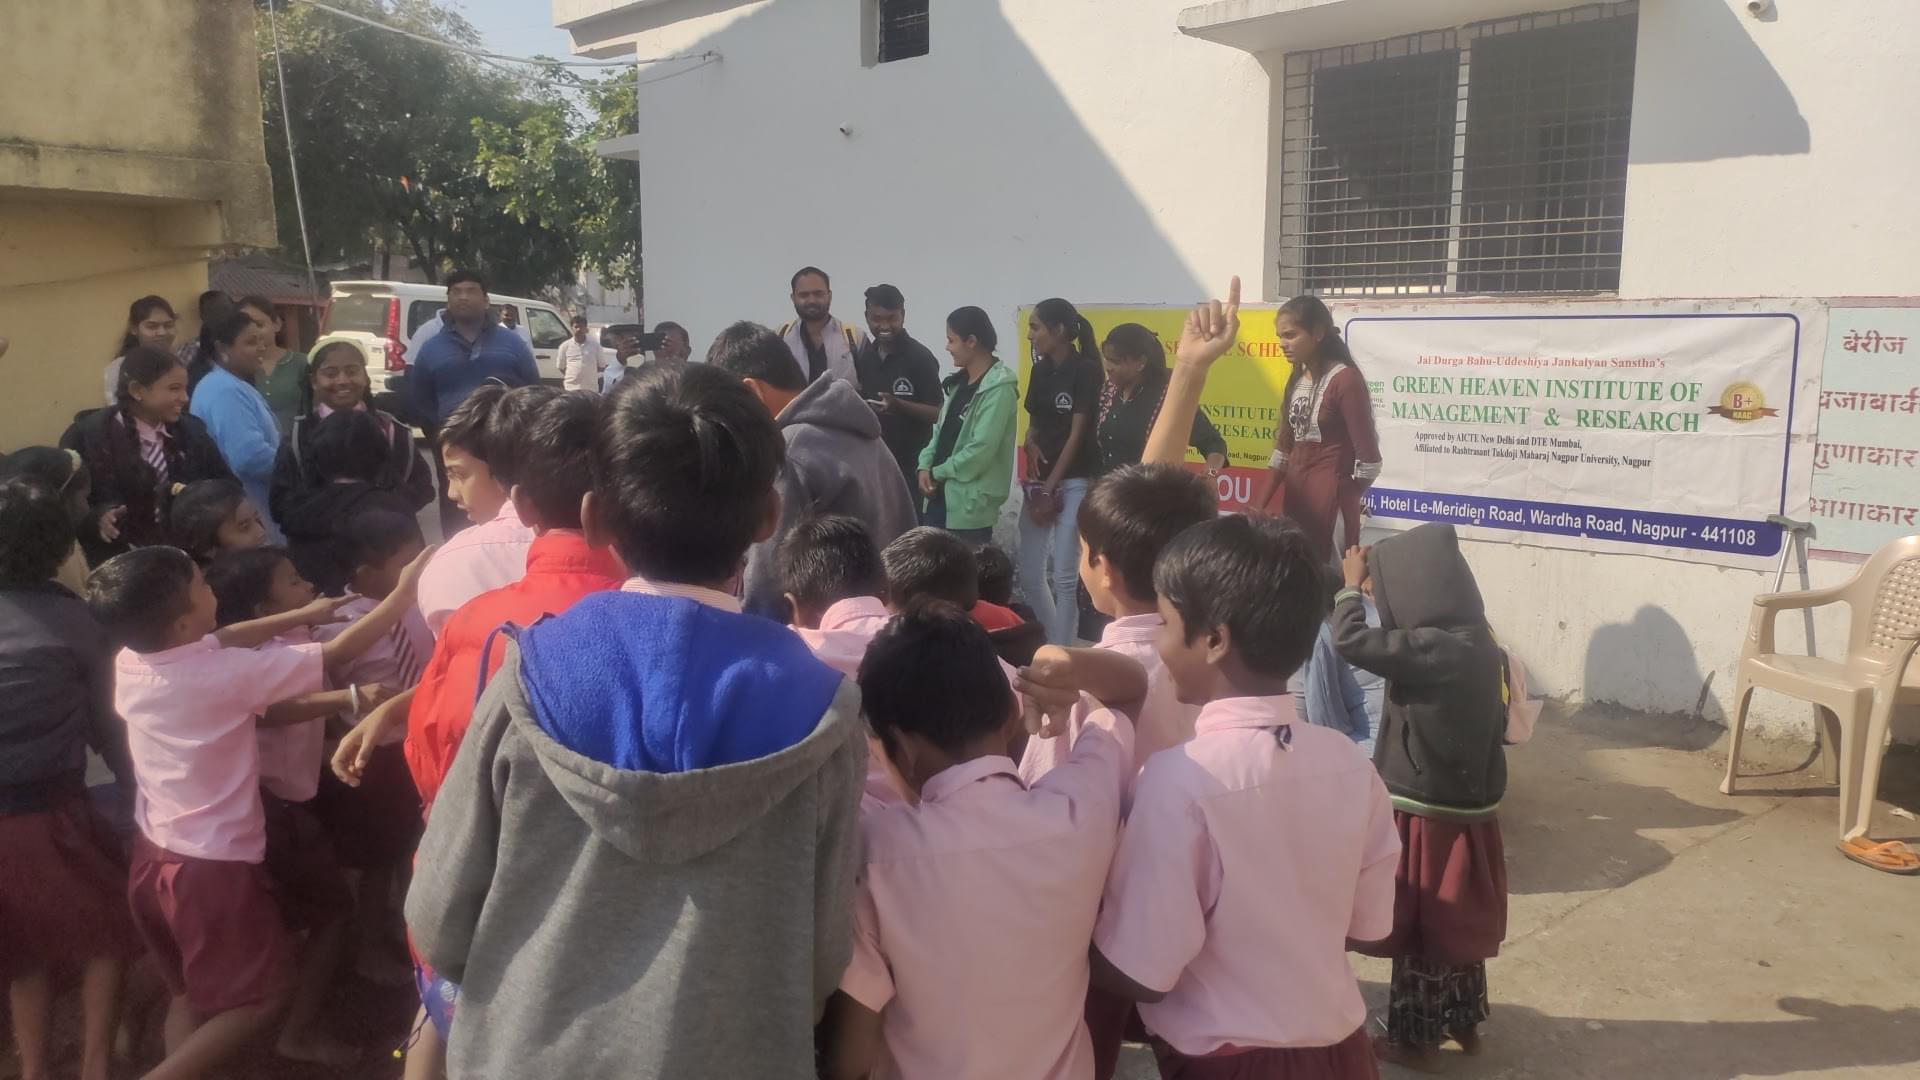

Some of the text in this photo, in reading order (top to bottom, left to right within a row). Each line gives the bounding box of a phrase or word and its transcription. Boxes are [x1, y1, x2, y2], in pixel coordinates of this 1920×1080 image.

[1237, 341, 1281, 358] SCHE
[1842, 328, 1909, 355] बेरीज
[1417, 355, 1431, 365] Jai
[1434, 355, 1464, 367] Durga
[1466, 356, 1549, 368] Bahu-Uddeshiya
[1551, 357, 1608, 370] Jankalyan
[1392, 375, 1703, 403] GREEN HEAVEN INSTITUTE OF
[1200, 403, 1278, 421] NSTITUTE
[1391, 401, 1700, 433] MANAGEMENT & RESEARCH
[1414, 431, 1583, 450] Approved by AICTE New Delhi and DTE Mumbai,
[1414, 443, 1443, 454] Affiliated
[1444, 445, 1451, 454] to
[1452, 445, 1490, 457] Rashtrasant
[1519, 449, 1550, 463] Maharaj
[1551, 451, 1579, 464] Nagpur
[1622, 455, 1652, 469] Nagpur
[1217, 474, 1251, 504] OU
[1380, 495, 1410, 512] Hotel
[1414, 498, 1485, 520] Le-Meridien
[1489, 505, 1526, 526] Road,
[1530, 509, 1582, 528] Wardha
[1586, 514, 1627, 536] Road,
[1631, 519, 1688, 541] Nagpur
[1700, 525, 1756, 547] 441108
